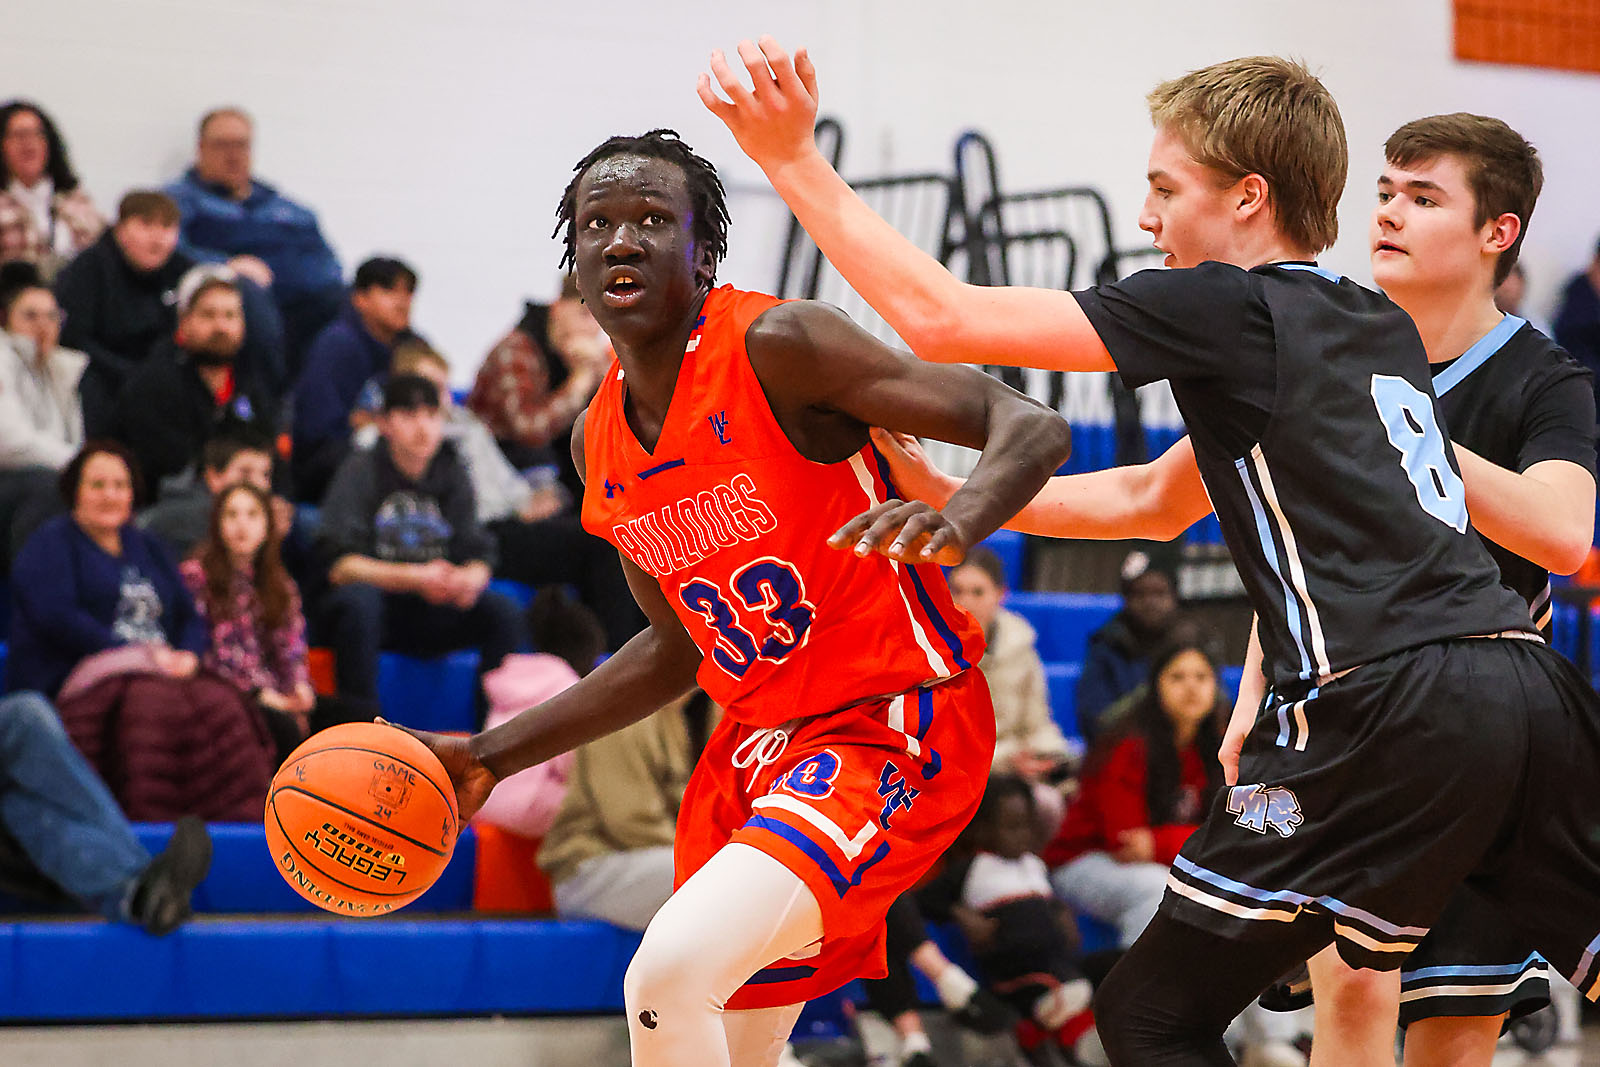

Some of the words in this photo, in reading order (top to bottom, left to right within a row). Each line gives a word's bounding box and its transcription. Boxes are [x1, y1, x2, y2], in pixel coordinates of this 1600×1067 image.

[1370, 373, 1469, 535] 8
[613, 473, 778, 578] BULLDOGS
[679, 555, 817, 681] 33
[374, 759, 416, 787] GAME
[321, 822, 384, 859] 1000
[373, 804, 392, 820] 24
[303, 829, 408, 886] LEGACY
